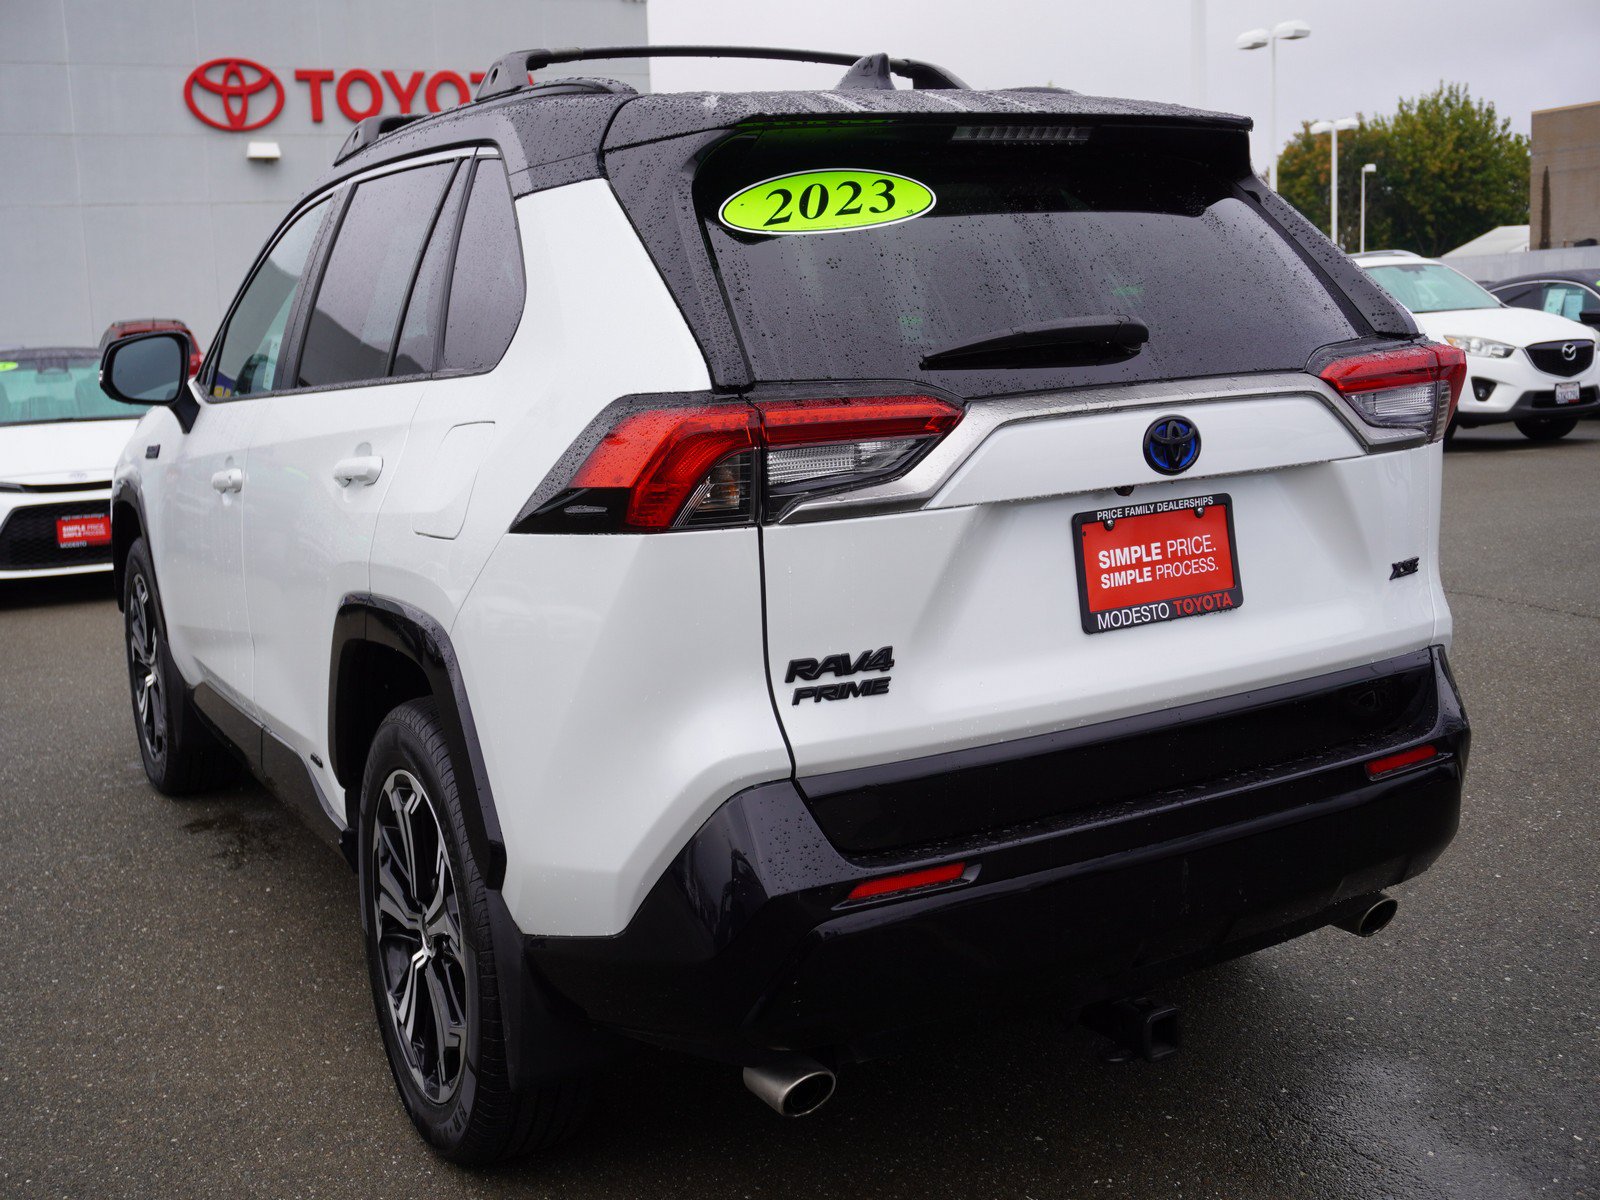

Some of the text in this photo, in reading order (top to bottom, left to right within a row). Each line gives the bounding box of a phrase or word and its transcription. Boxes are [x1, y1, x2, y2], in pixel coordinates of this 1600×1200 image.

[295, 69, 534, 122] TOYO
[762, 178, 897, 227] 2023
[1097, 496, 1214, 521] PRICE FAMILY DEALERSHIPS
[1098, 534, 1217, 570] SIMPLE PRICE.
[1101, 556, 1219, 589] SIMPLE PROCESS.
[1097, 592, 1233, 630] MODESTO TOYOTA
[784, 645, 895, 684] RAV4
[791, 676, 892, 706] PRIME
